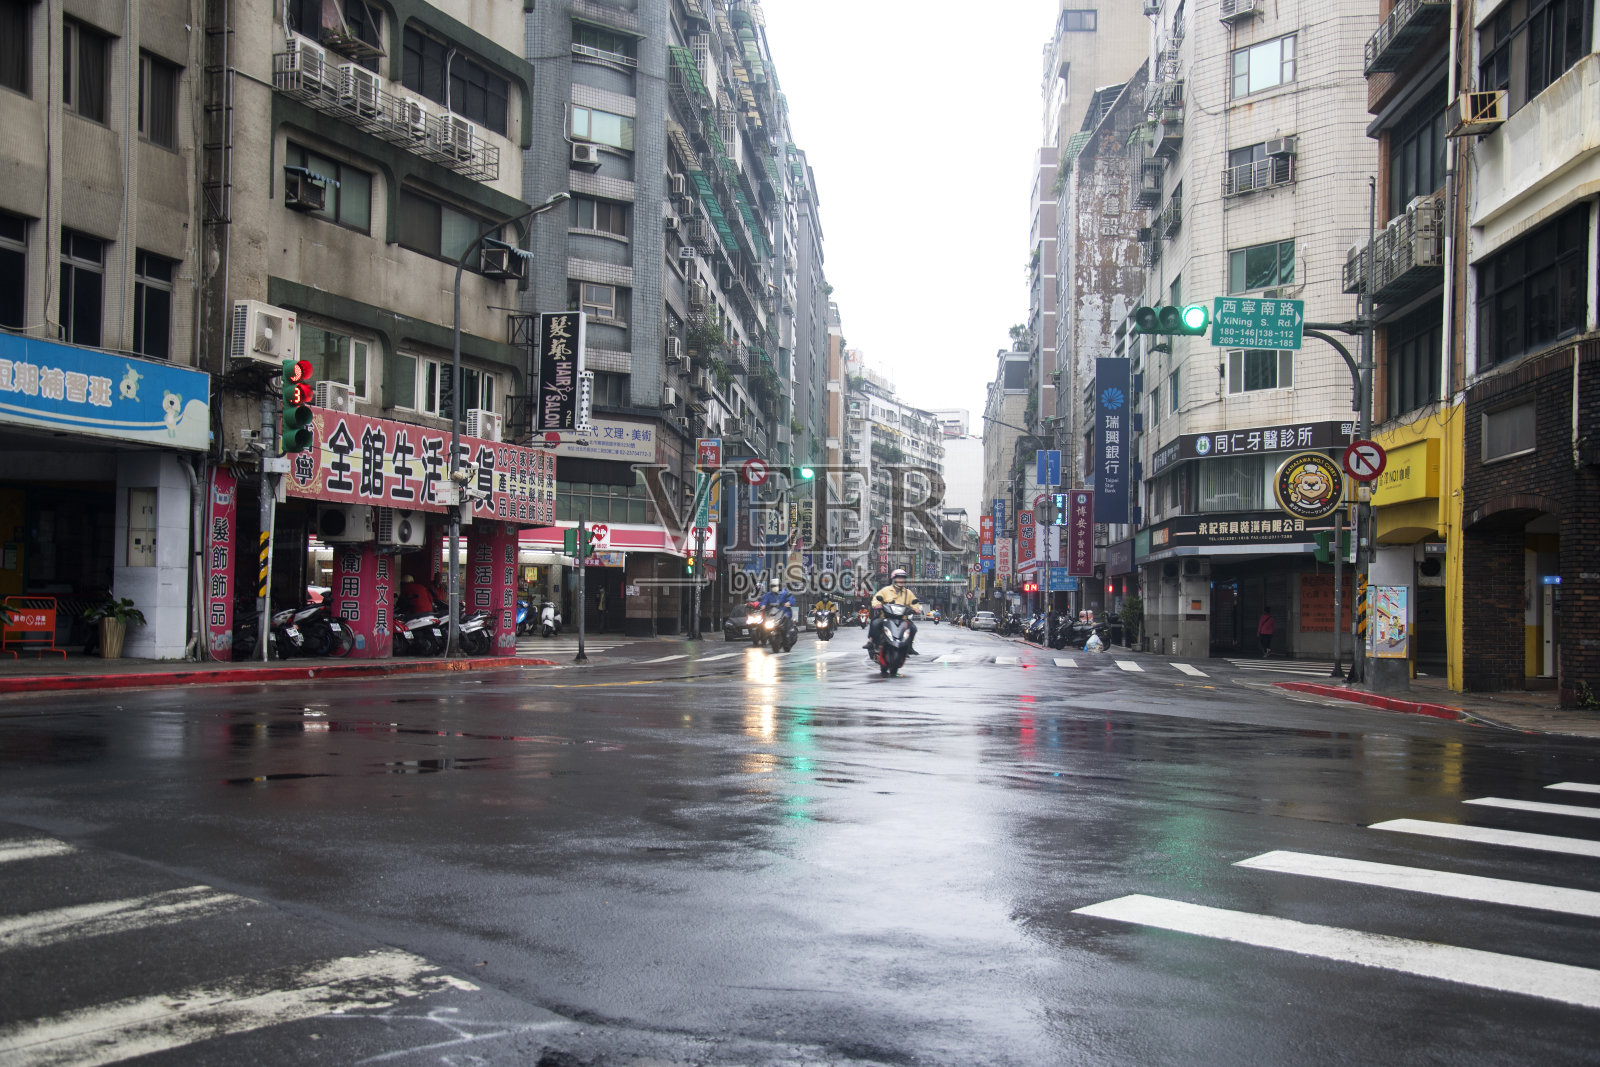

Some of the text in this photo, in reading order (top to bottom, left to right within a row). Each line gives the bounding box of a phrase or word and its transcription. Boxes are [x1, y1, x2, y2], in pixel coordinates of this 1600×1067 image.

[1222, 300, 1295, 316] 西寧南路
[1223, 317, 1253, 327] XiNing
[548, 316, 572, 360] 髮藝
[1219, 337, 1294, 347] 269-219 215-185
[1220, 328, 1294, 338] 180-146 138-112
[556, 362, 572, 386] HAIR
[545, 395, 561, 428] SALON
[566, 410, 572, 427] 2F
[1105, 415, 1120, 474] 瑞興銀行
[1214, 426, 1313, 454] 同仁牙醫診所
[509, 450, 518, 518] 文具玩具
[519, 452, 527, 520] 家庭五金
[1198, 518, 1305, 535] 永記家具裝潢有限公司
[210, 517, 230, 627] 髮飾飾品
[473, 543, 494, 617] 生活百
[502, 544, 514, 630] 髮飾飾品
